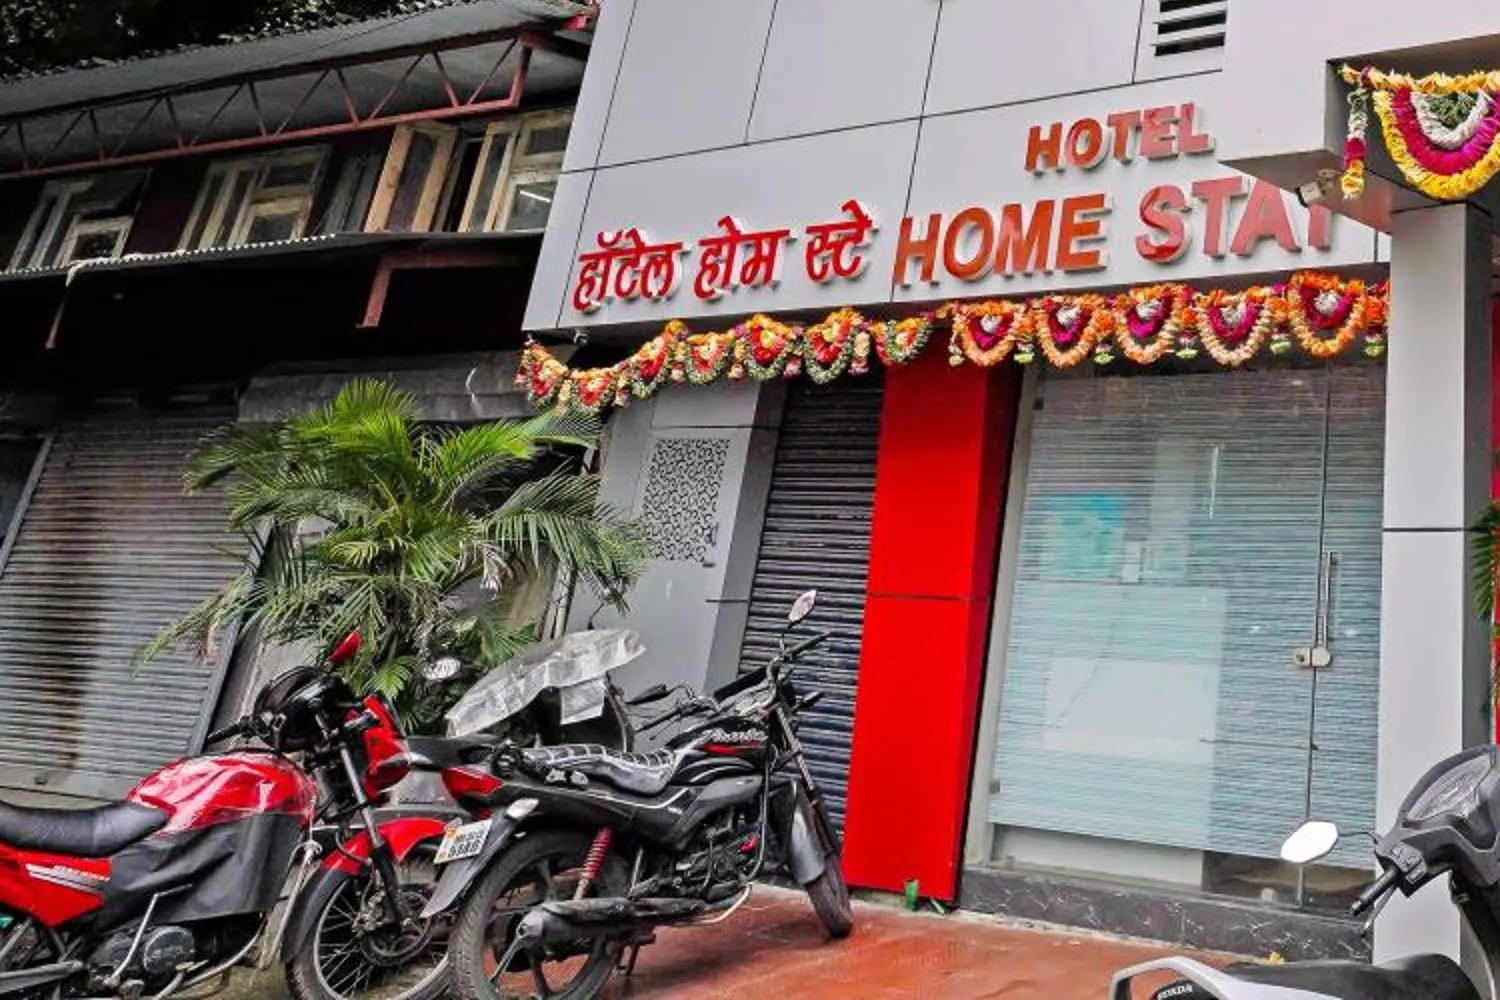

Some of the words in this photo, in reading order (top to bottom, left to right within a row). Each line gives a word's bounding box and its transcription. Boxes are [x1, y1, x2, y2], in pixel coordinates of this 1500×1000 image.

[1026, 101, 1214, 174] HOTEL
[573, 227, 685, 312] हॉटेल
[693, 215, 791, 299] होम
[805, 199, 873, 282] स्टे
[893, 193, 1110, 287] HOME
